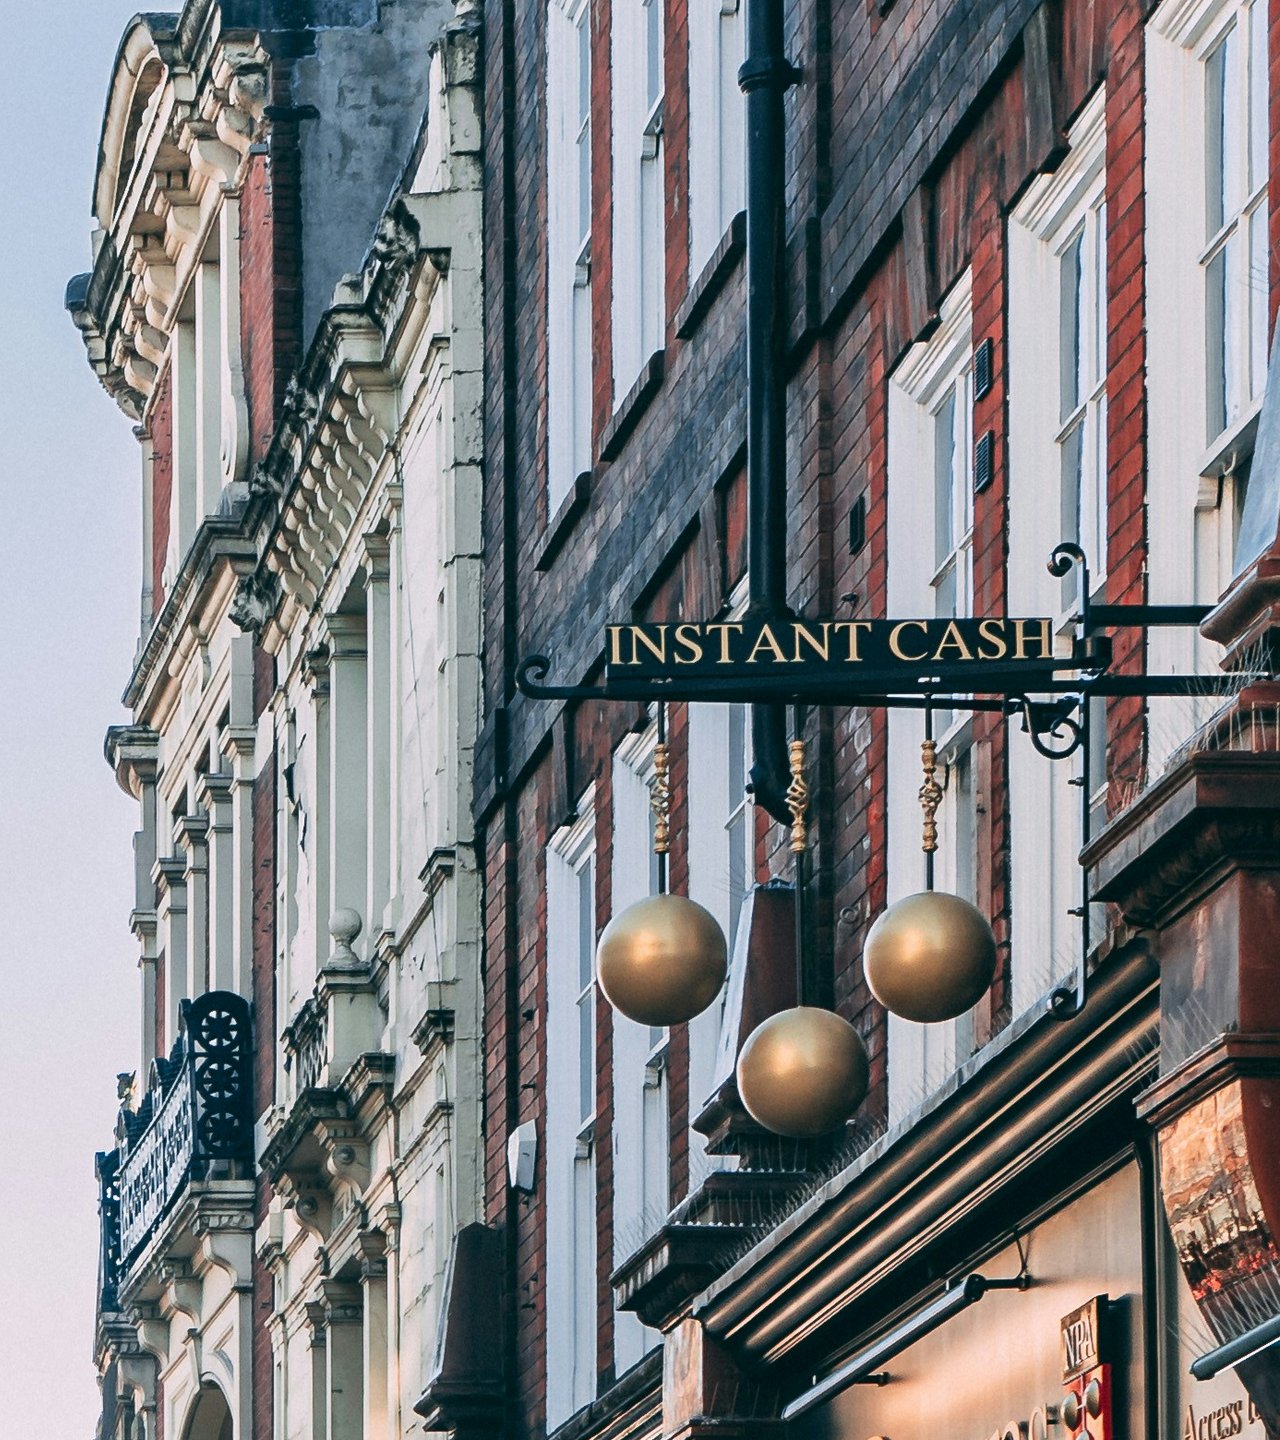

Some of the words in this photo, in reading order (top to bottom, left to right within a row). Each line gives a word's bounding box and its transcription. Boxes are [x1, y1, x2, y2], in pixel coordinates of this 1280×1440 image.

[609, 622, 872, 666] INSTANT
[889, 617, 1054, 662] CASH
[1063, 1314, 1096, 1370] NPA
